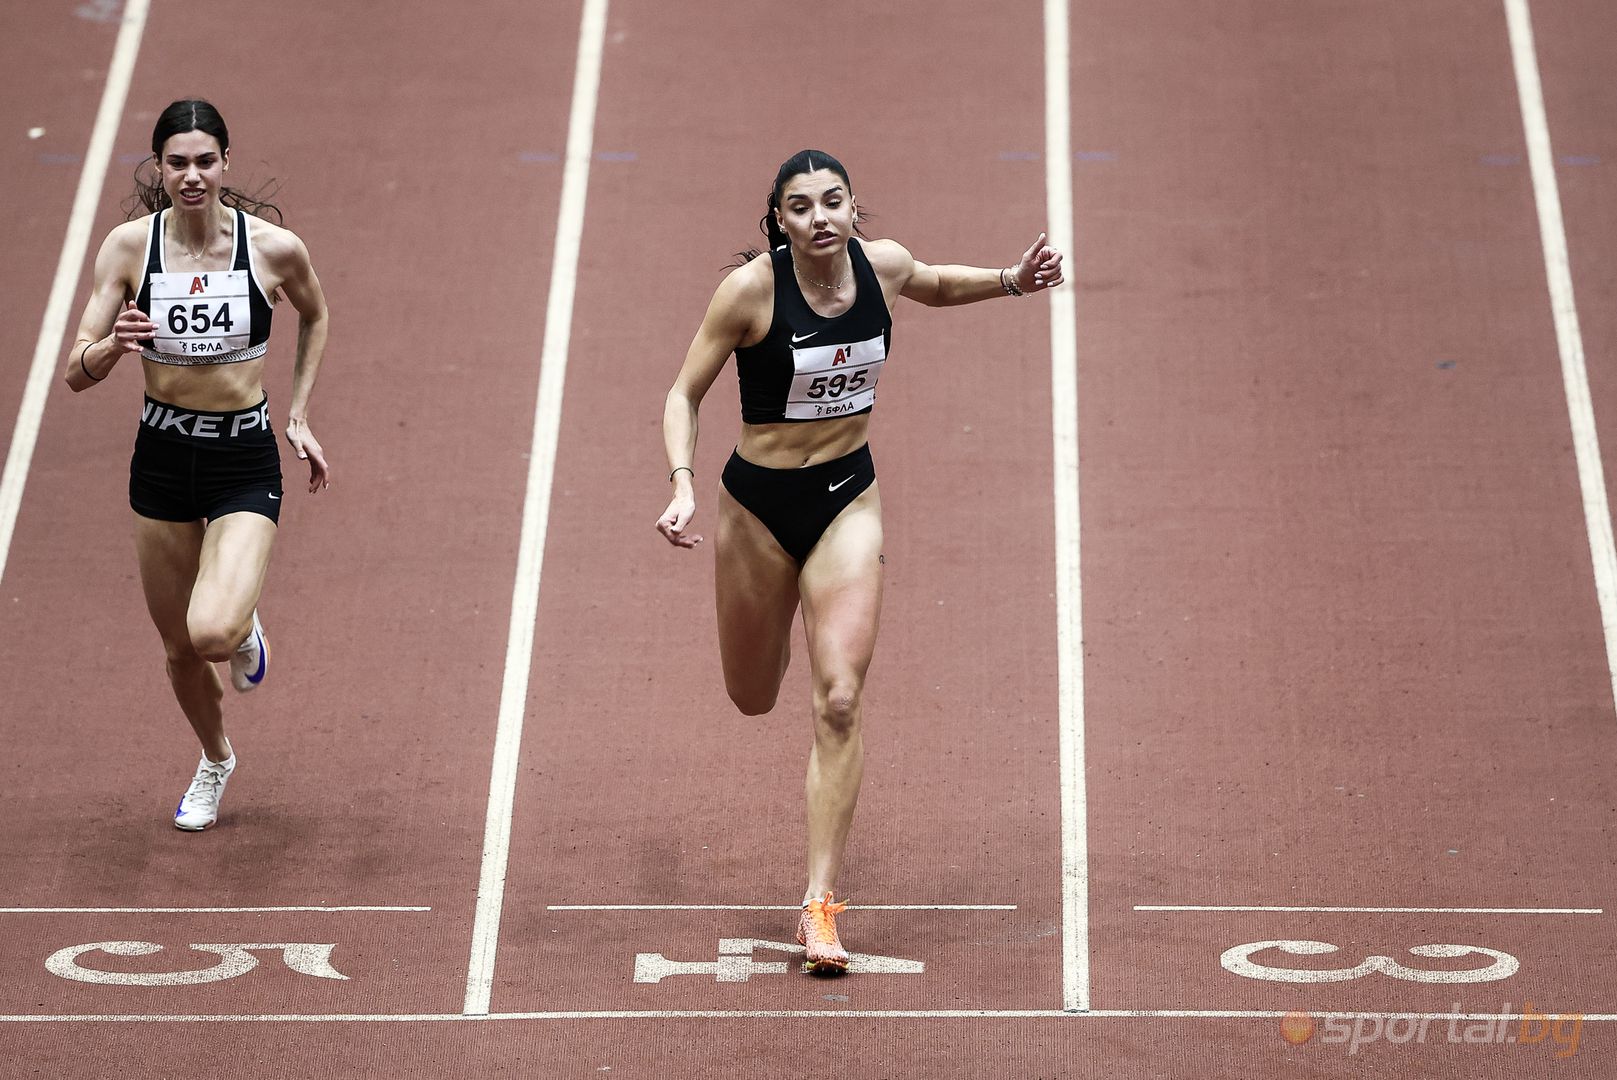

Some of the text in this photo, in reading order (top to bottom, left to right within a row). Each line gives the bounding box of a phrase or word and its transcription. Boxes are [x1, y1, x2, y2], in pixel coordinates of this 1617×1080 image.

[189, 274, 208, 294] A1
[168, 302, 234, 335] 654
[191, 342, 222, 352] БФЛА
[832, 345, 851, 366] A1
[807, 368, 869, 399] 595
[826, 402, 854, 414] БФЛА
[45, 941, 351, 986] 5
[633, 938, 925, 983] 4
[1220, 939, 1520, 984] 3
